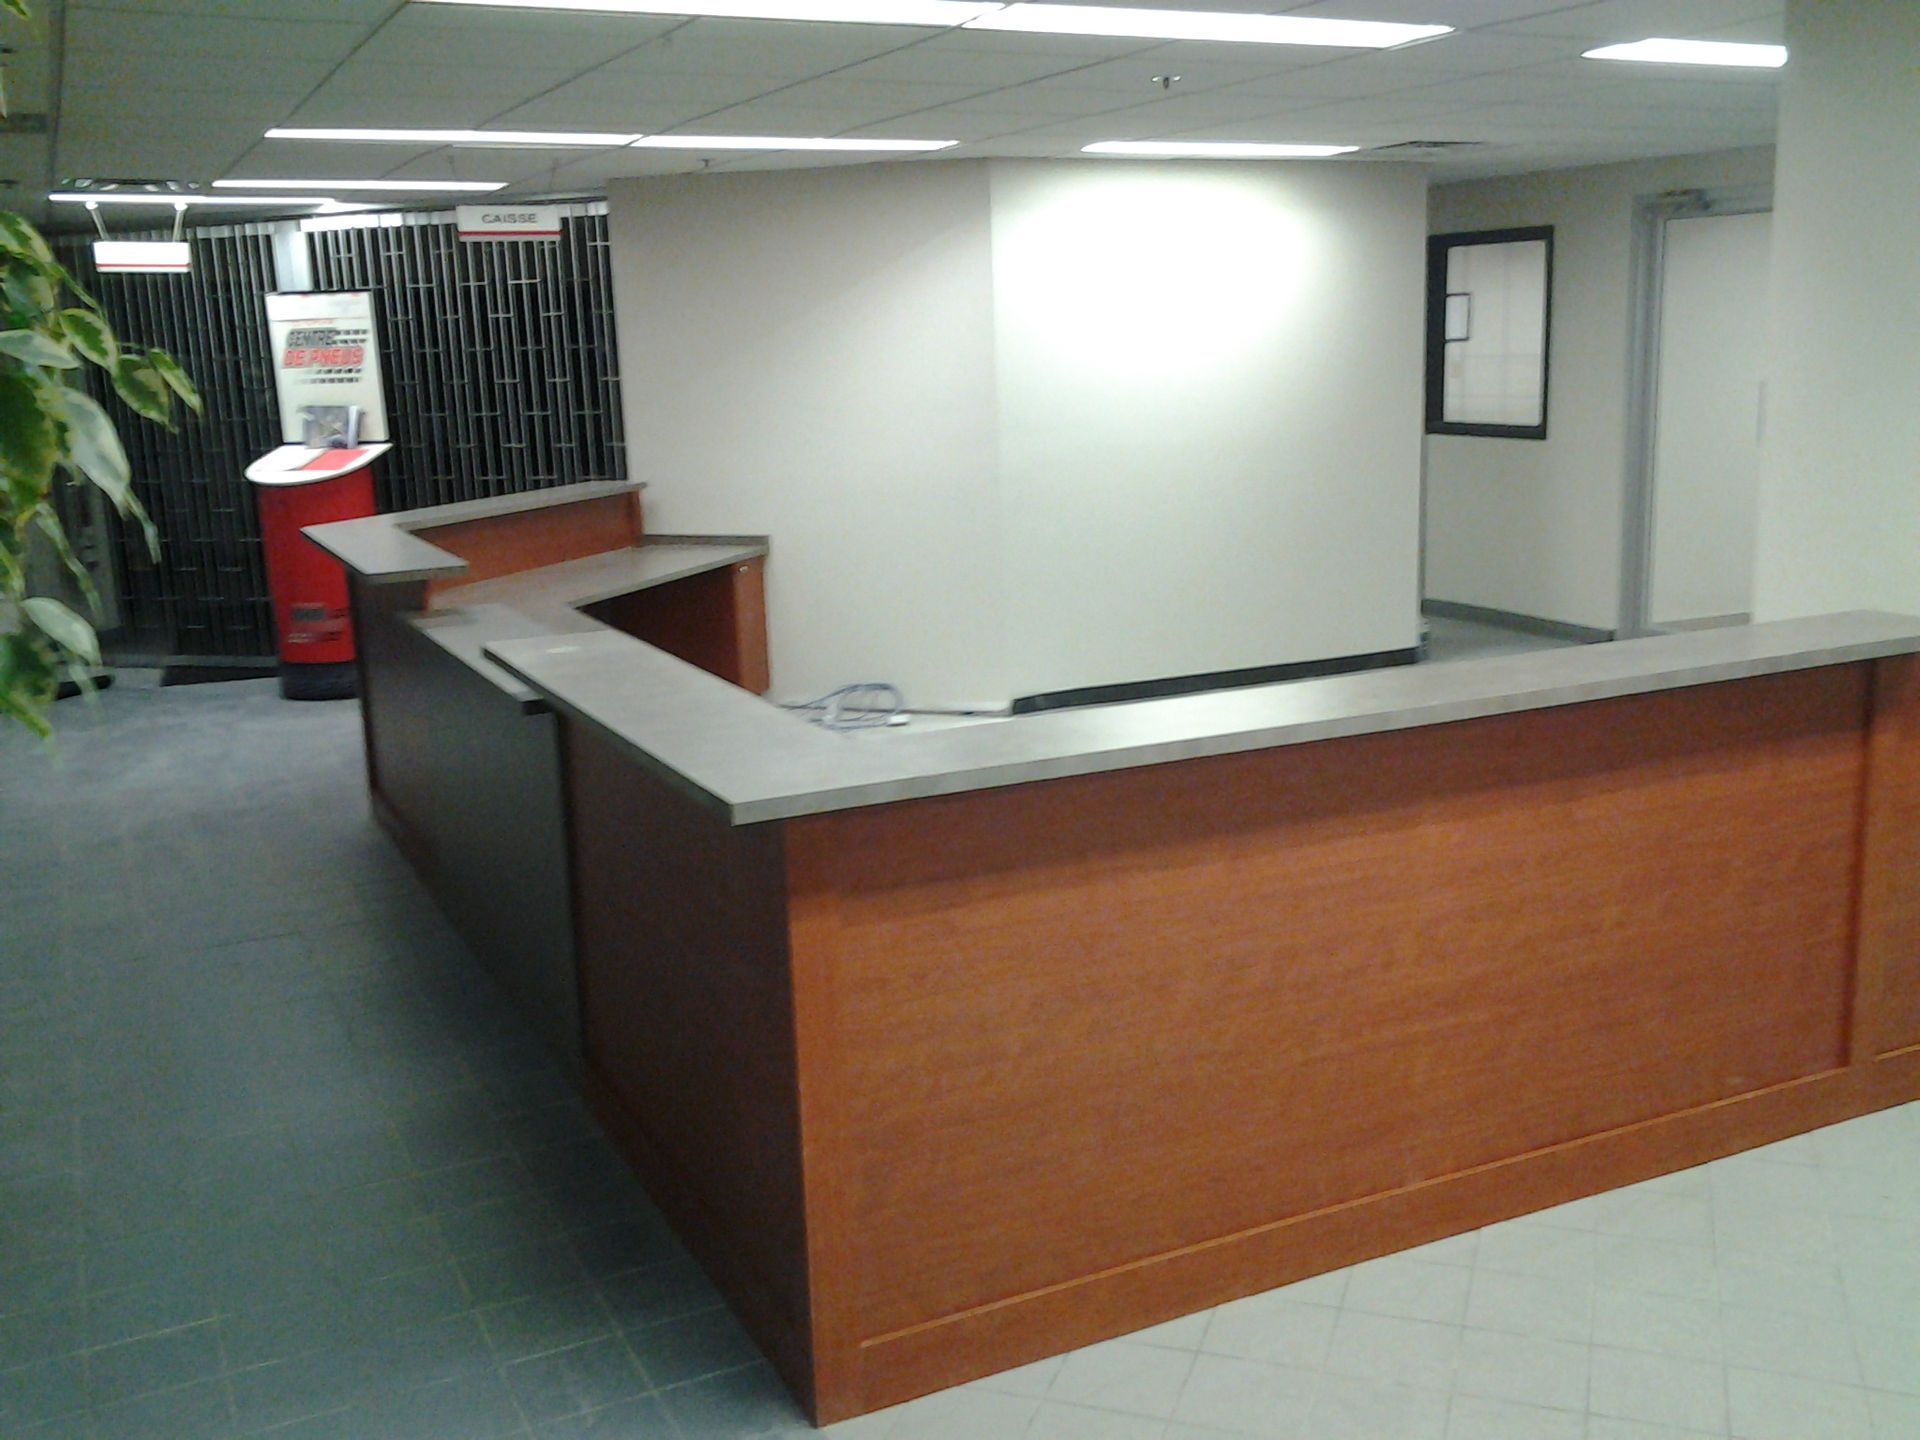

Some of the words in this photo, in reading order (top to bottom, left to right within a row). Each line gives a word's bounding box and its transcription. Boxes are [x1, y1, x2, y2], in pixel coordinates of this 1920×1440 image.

[481, 213, 538, 224] CAISSE
[284, 348, 306, 367] DE
[308, 347, 364, 366] PNEUS
